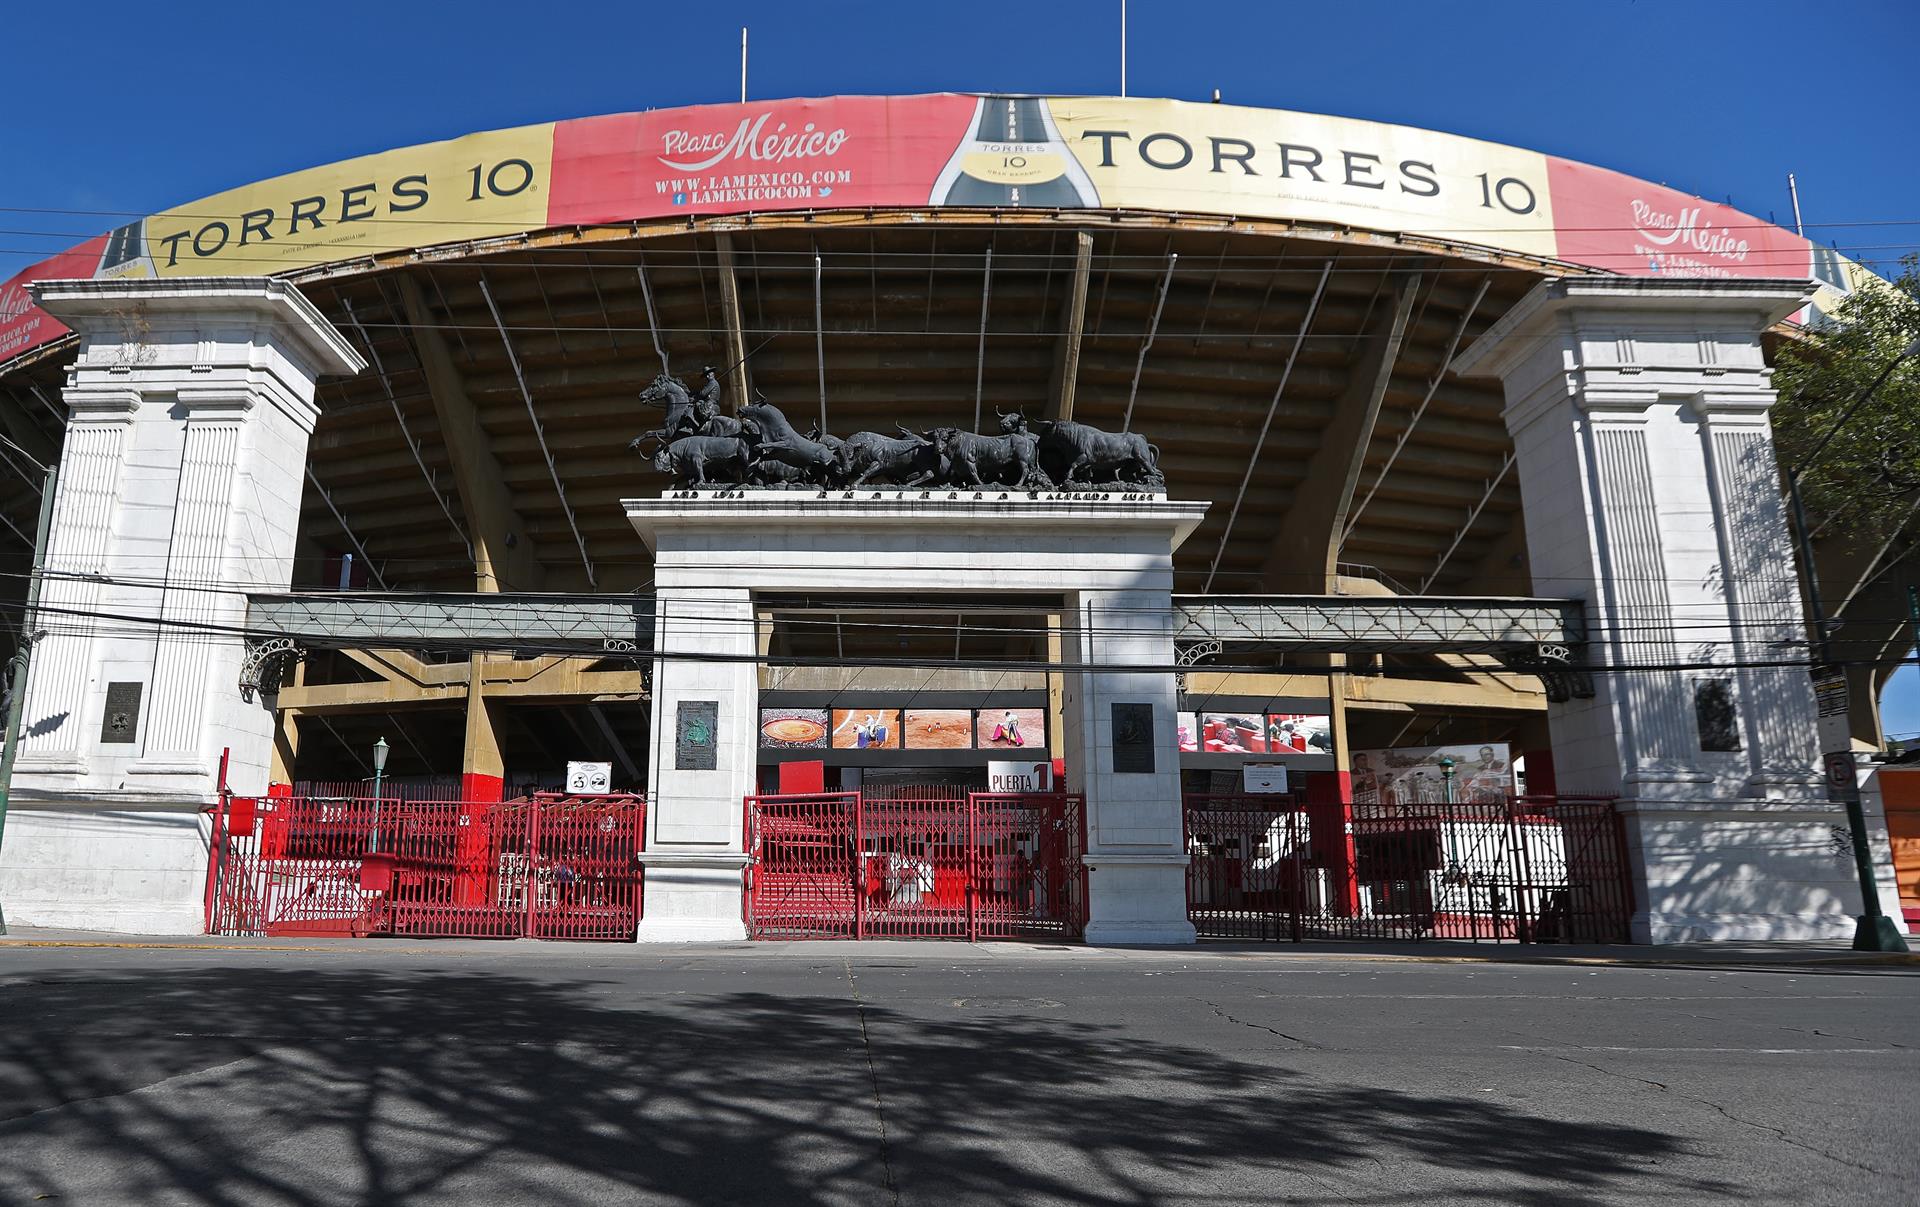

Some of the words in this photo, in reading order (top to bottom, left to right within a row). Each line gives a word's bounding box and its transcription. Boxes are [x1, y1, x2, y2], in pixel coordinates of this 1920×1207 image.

[662, 130, 726, 156] Plaza
[716, 112, 851, 167] México
[983, 143, 1045, 153] TORRES
[1003, 156, 1027, 168] 10
[1080, 129, 1441, 198] TORRES
[1475, 171, 1537, 216] 10
[655, 169, 852, 194] WWW.LAMEXICO.COM
[691, 185, 813, 205] LAMEXICOCOM
[159, 173, 429, 269] TORRES
[466, 158, 534, 201] 10
[992, 774, 1032, 791] PUERTA
[1033, 763, 1049, 792] 1
